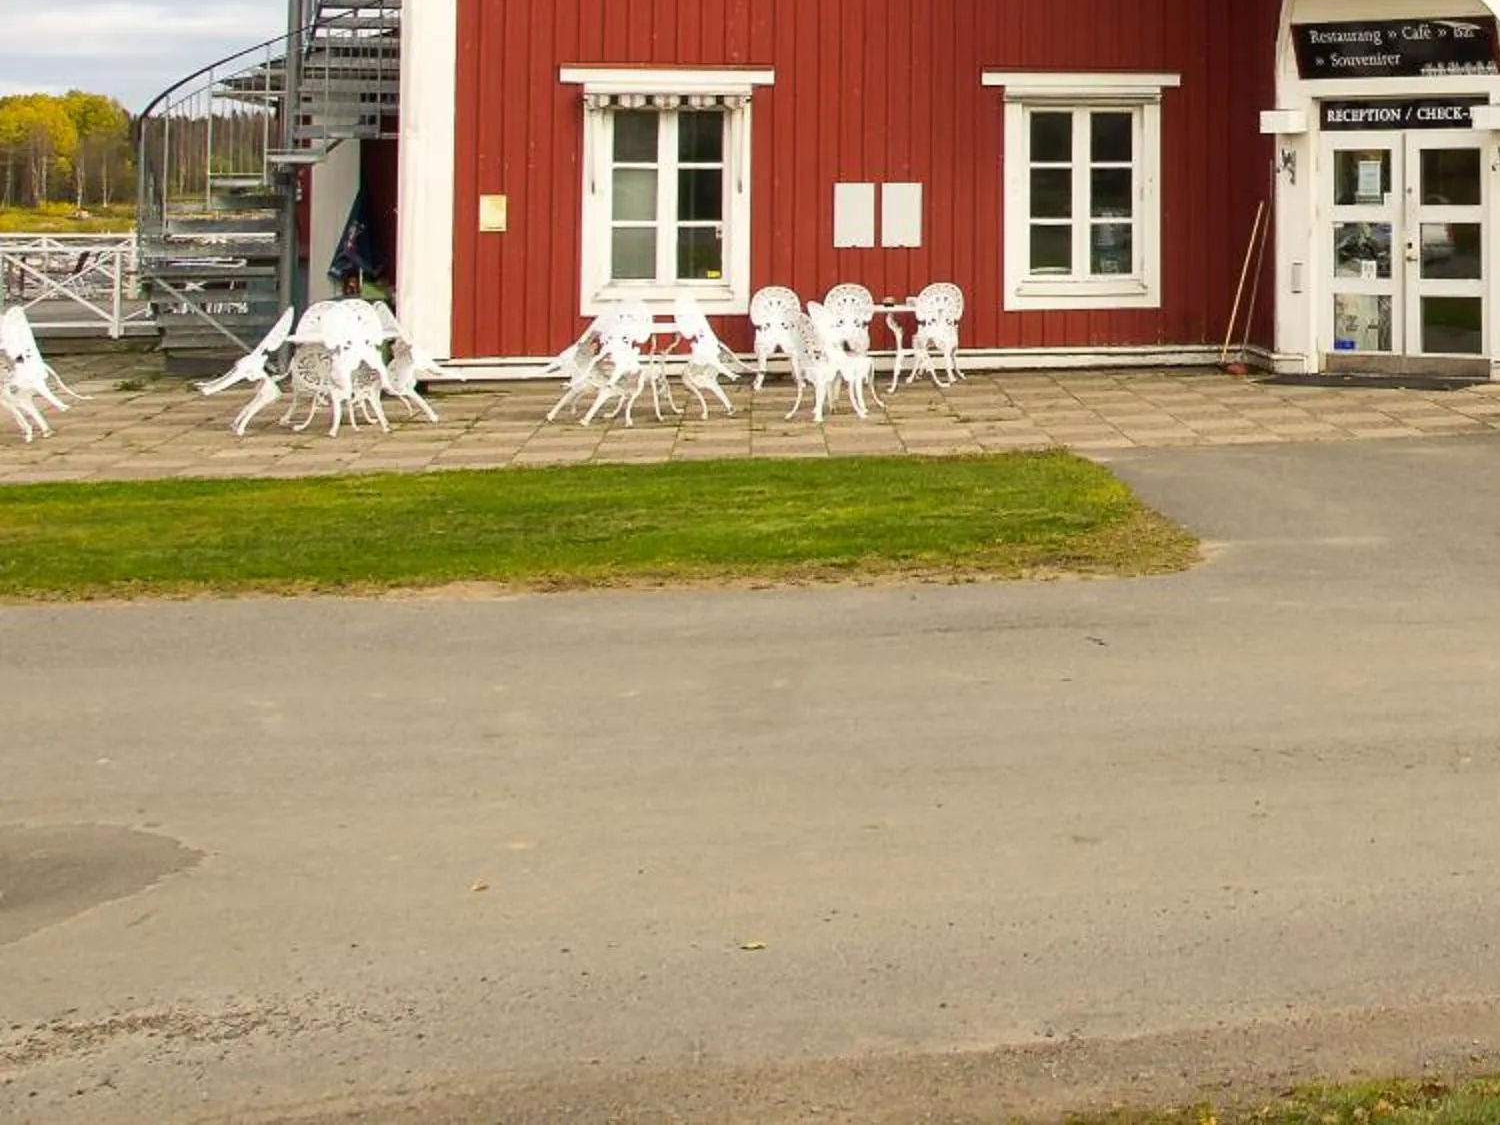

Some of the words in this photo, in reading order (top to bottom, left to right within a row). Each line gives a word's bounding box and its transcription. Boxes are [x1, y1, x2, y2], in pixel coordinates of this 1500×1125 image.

[1308, 29, 1382, 45] Restaurang
[1401, 23, 1432, 40] Café
[1330, 52, 1401, 67] Souvenirer
[1327, 108, 1401, 122] RECEPTION
